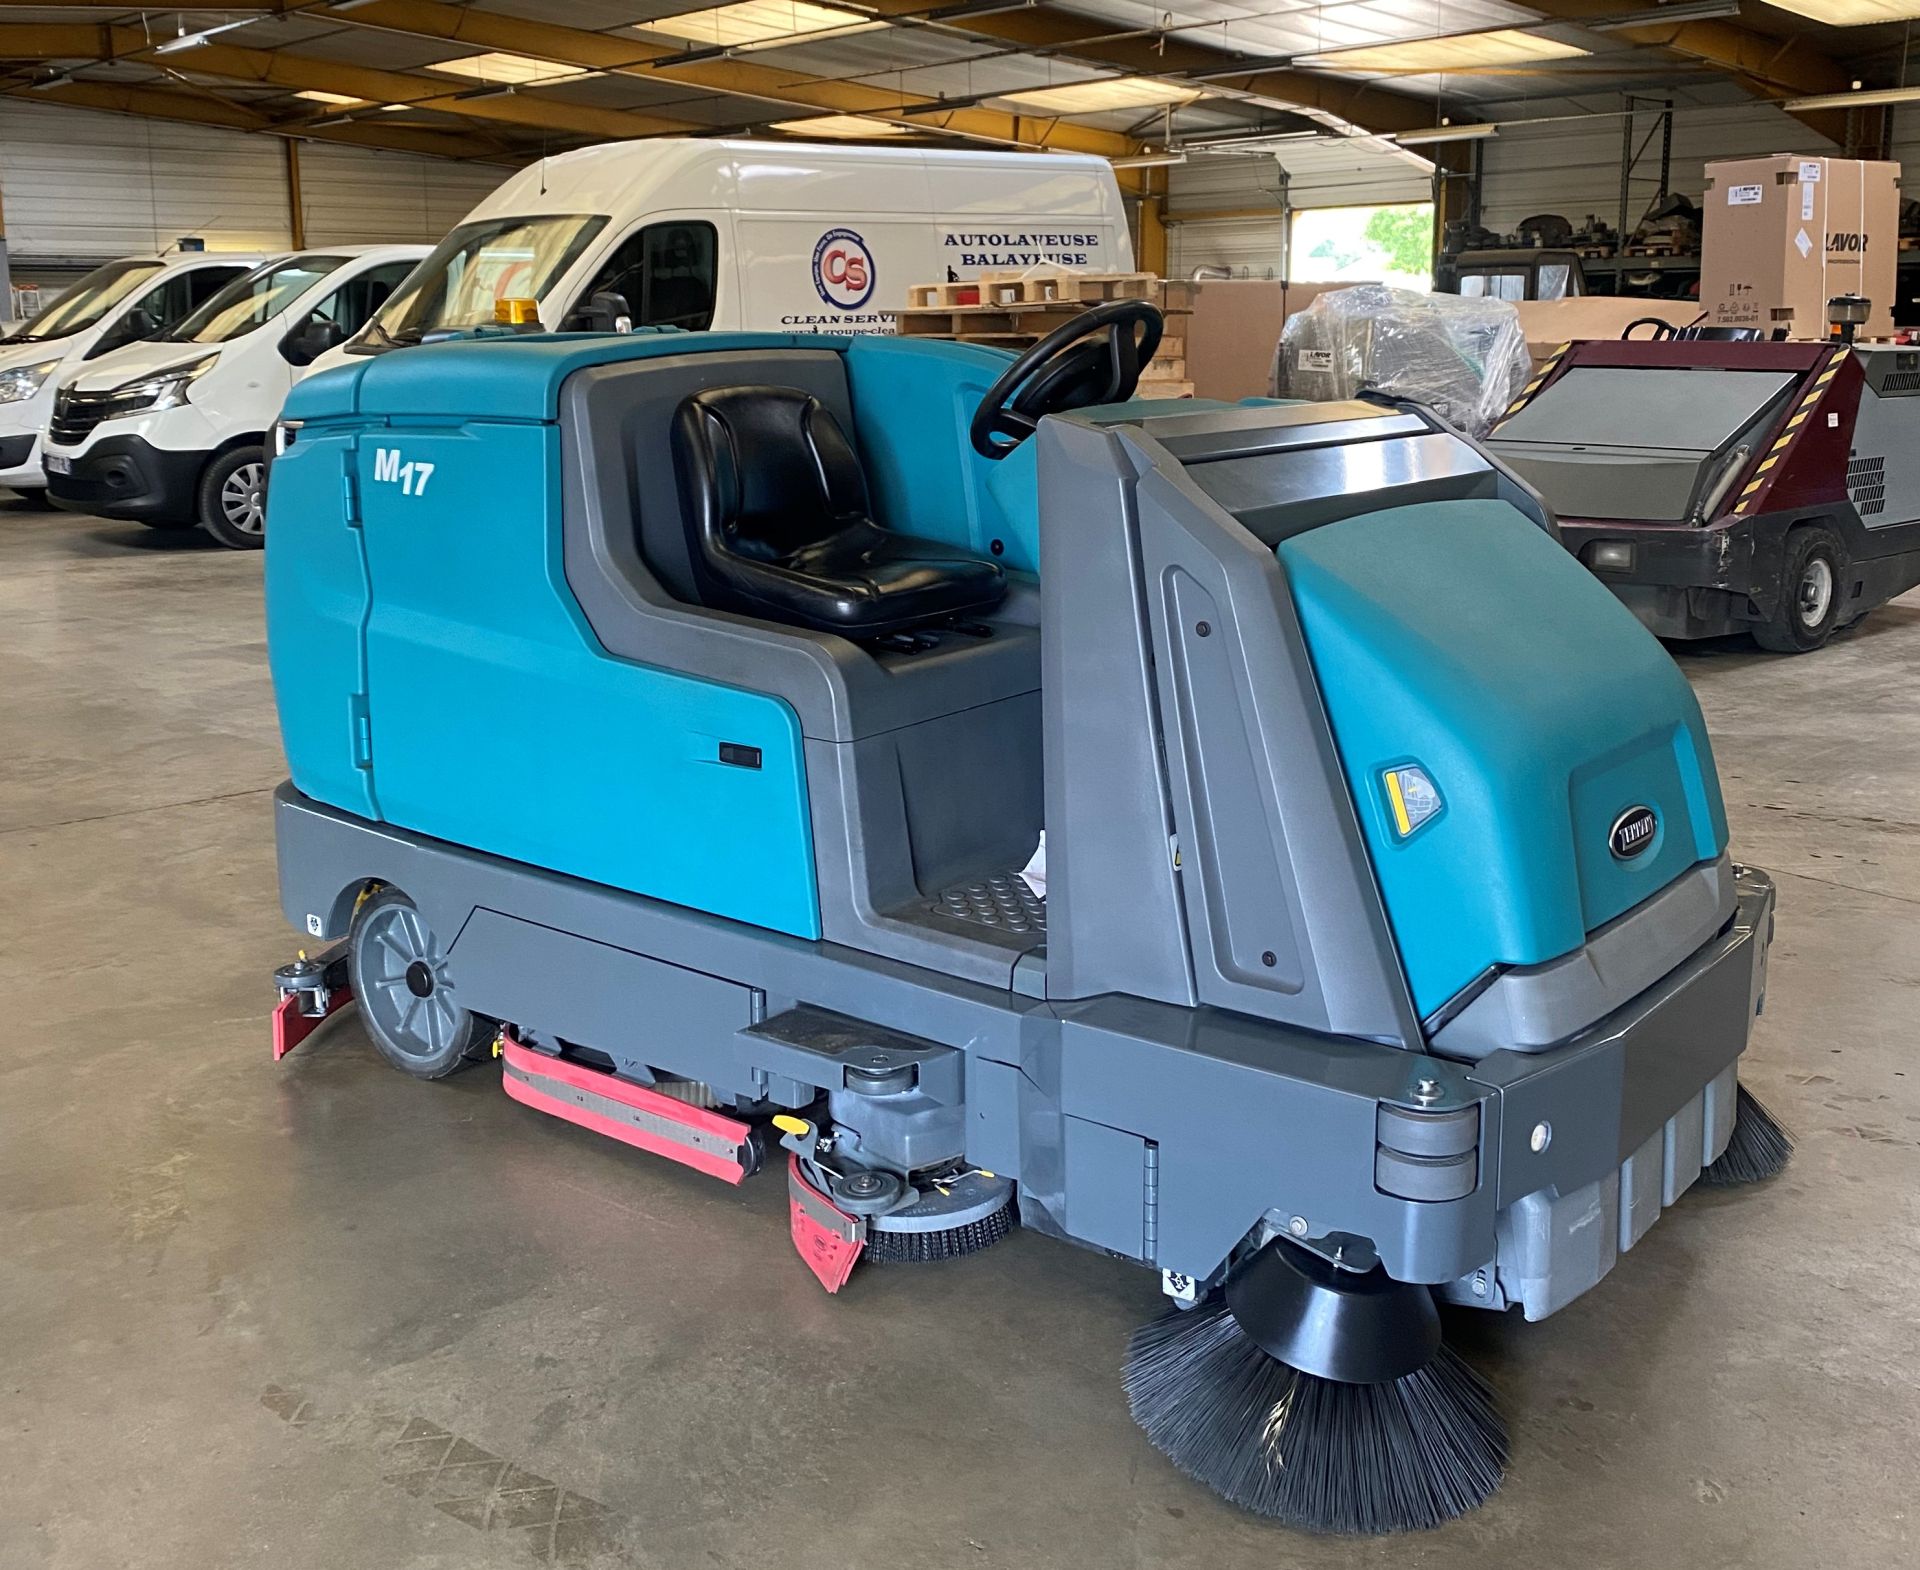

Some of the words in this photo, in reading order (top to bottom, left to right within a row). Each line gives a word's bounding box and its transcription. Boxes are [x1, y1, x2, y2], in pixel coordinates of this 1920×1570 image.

[944, 234, 1098, 246] AUTOLAVEUSE
[1825, 232, 1868, 252] LAVOR
[961, 253, 1087, 266] BALAYEUSE
[781, 315, 841, 325] CLEAN
[374, 448, 435, 496] M17
